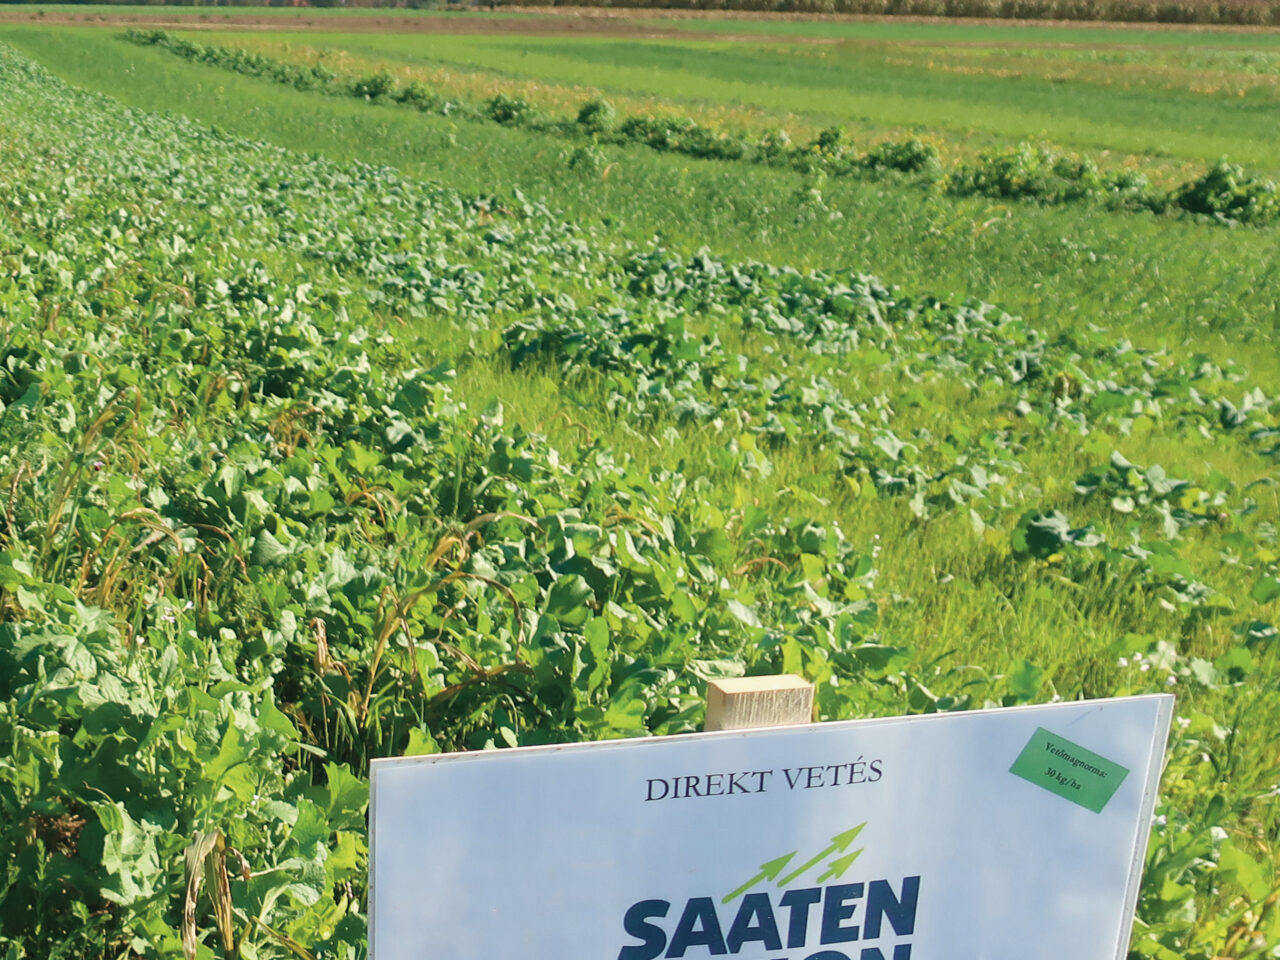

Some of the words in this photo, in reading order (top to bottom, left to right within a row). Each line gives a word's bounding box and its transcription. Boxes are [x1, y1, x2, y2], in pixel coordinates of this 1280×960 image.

[644, 769, 773, 801] DIREKT
[782, 755, 883, 790] VETÉS
[1044, 767, 1056, 778] 30
[1055, 772, 1081, 791] kg/ha
